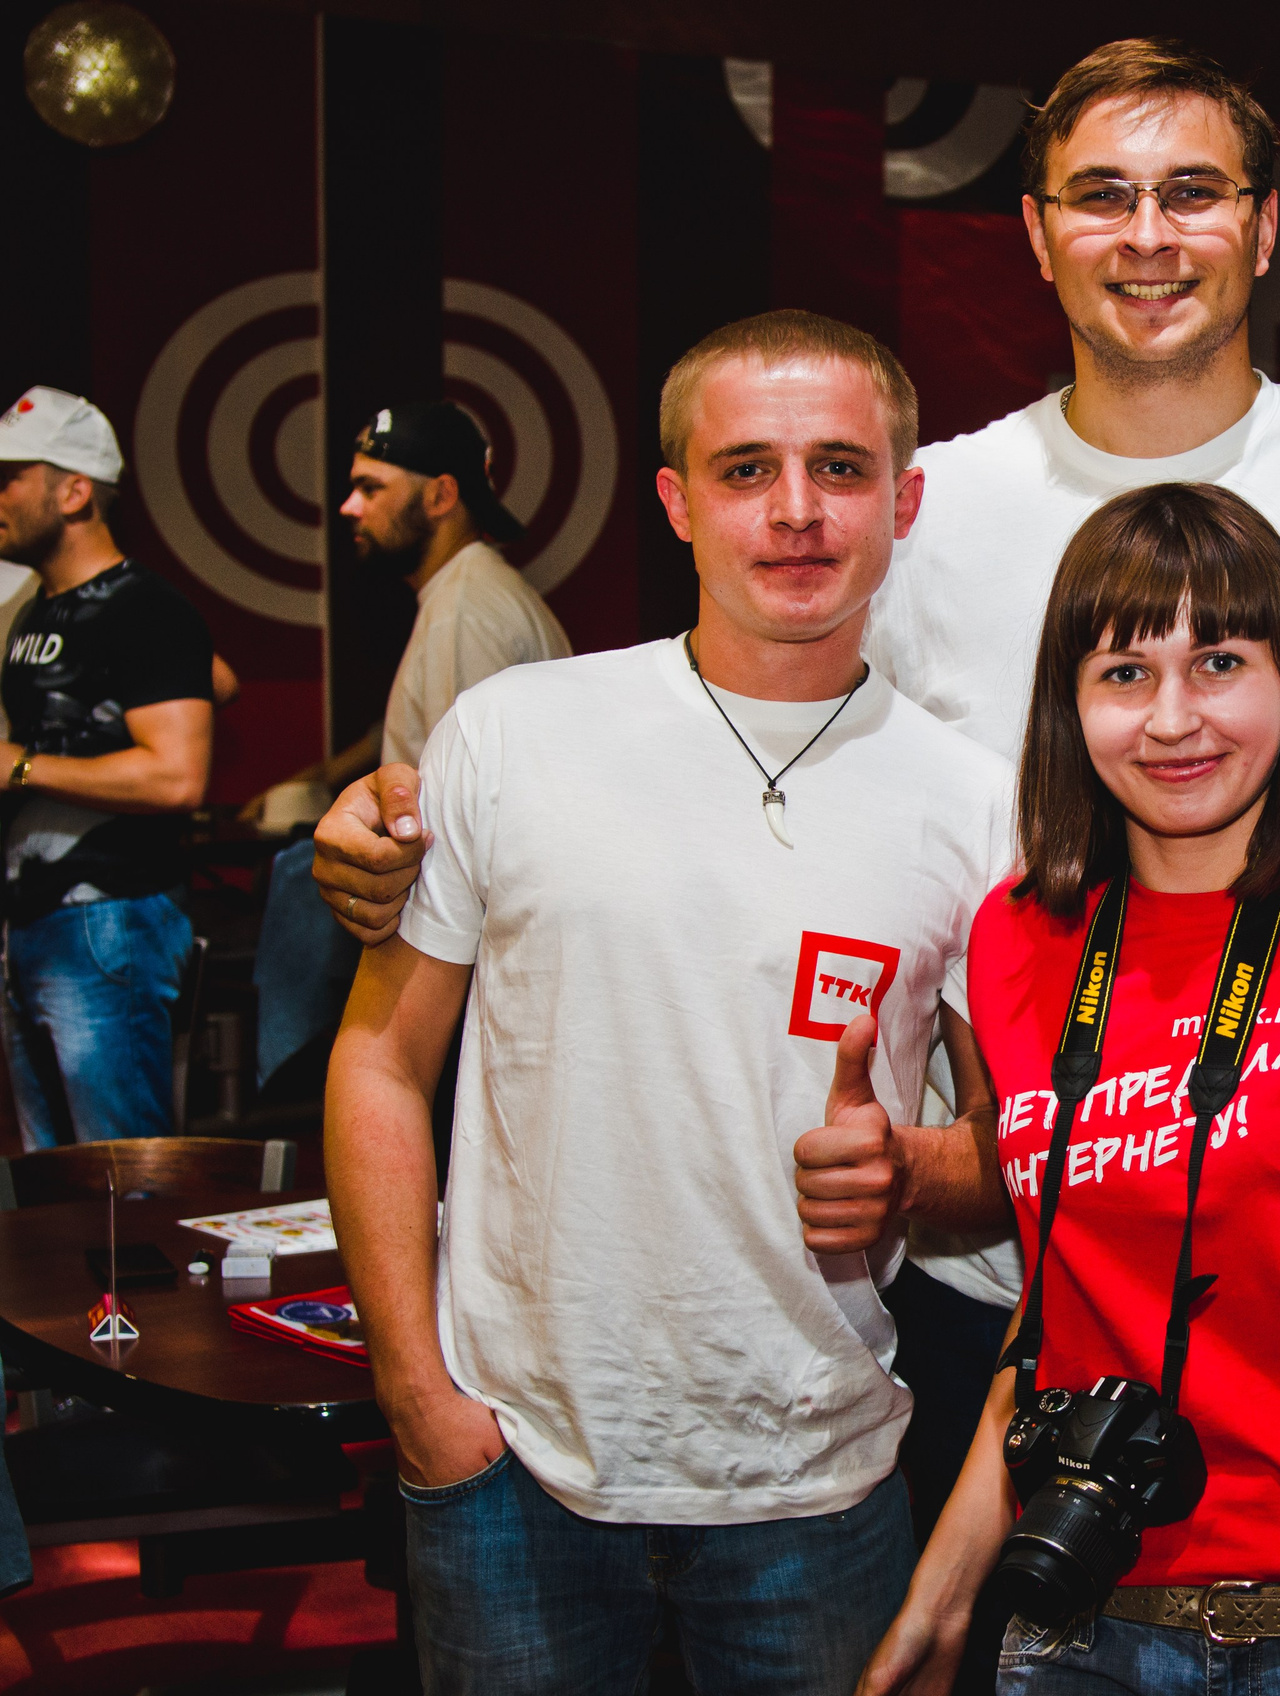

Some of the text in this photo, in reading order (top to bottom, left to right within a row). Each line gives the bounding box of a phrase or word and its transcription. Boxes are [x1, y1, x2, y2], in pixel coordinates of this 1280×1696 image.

[9, 632, 63, 665] WILD
[818, 973, 872, 1007] ТТК
[1076, 951, 1108, 1025] Nikon
[1215, 962, 1254, 1039] Nikon
[1058, 1455, 1091, 1471] Nikon
